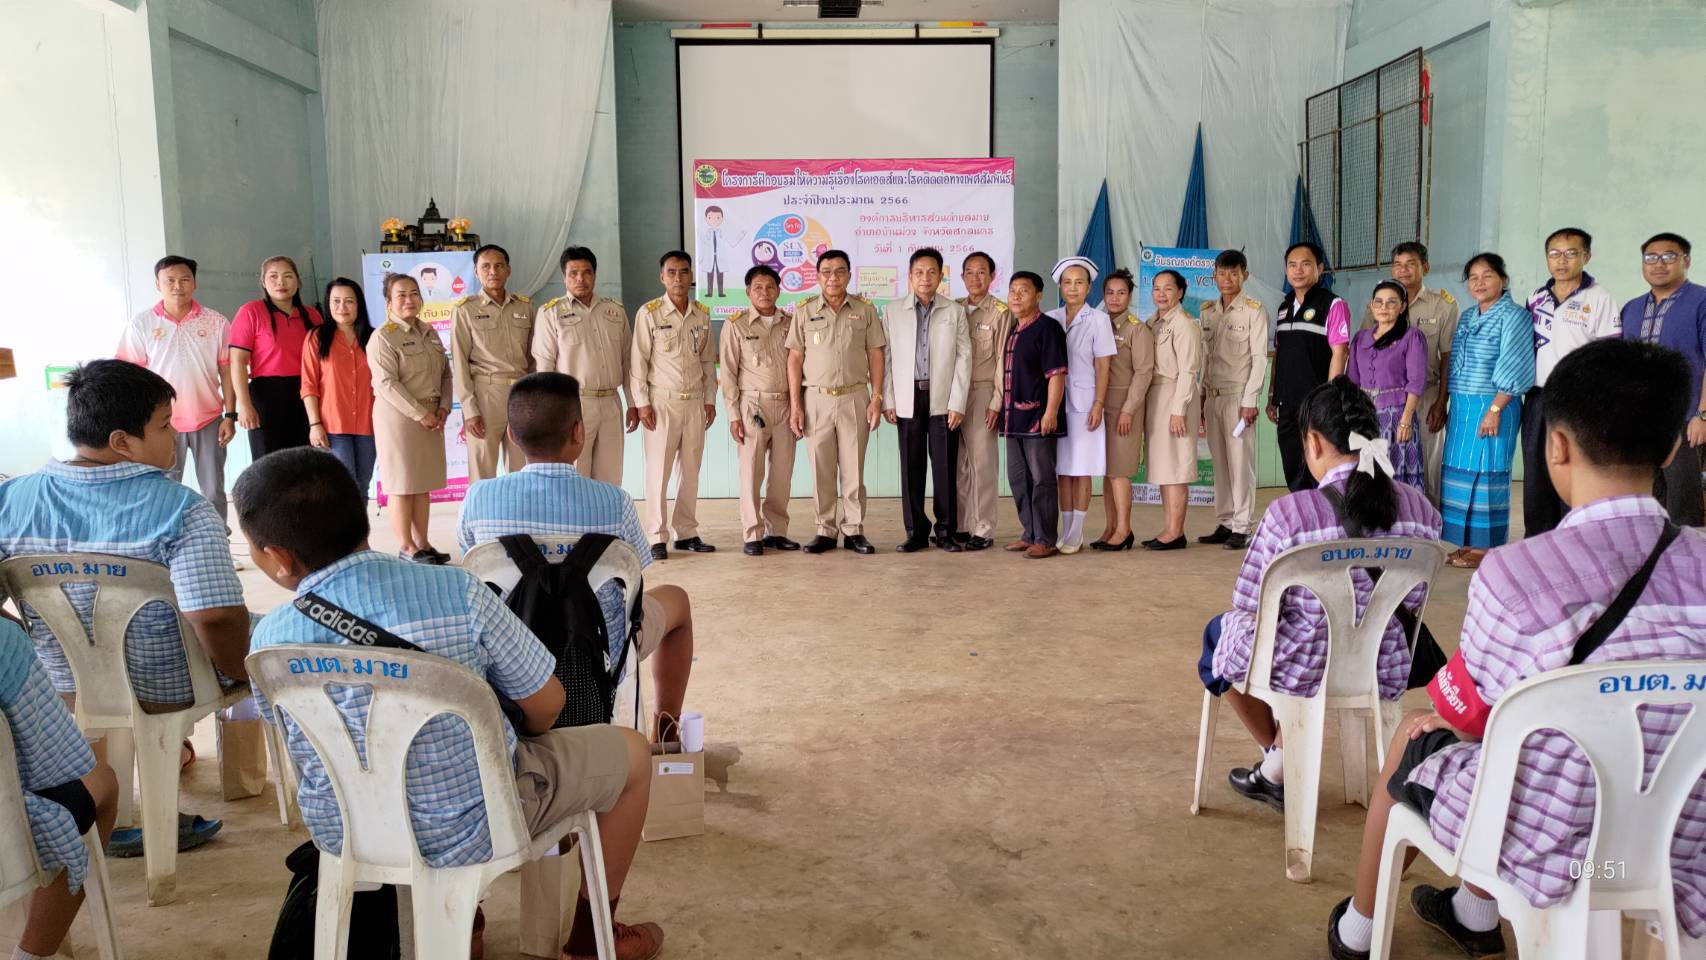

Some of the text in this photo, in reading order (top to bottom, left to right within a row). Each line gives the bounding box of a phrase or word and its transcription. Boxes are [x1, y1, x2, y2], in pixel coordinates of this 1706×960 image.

[784, 194, 909, 205] ประจำปีงบประมาณ 2566
[1320, 546, 1412, 561] อบต. มาย
[30, 561, 127, 577] อบต. มาย
[309, 603, 379, 646] adidas
[287, 656, 408, 679] อบต. มาย
[1598, 674, 1676, 694] อบต.
